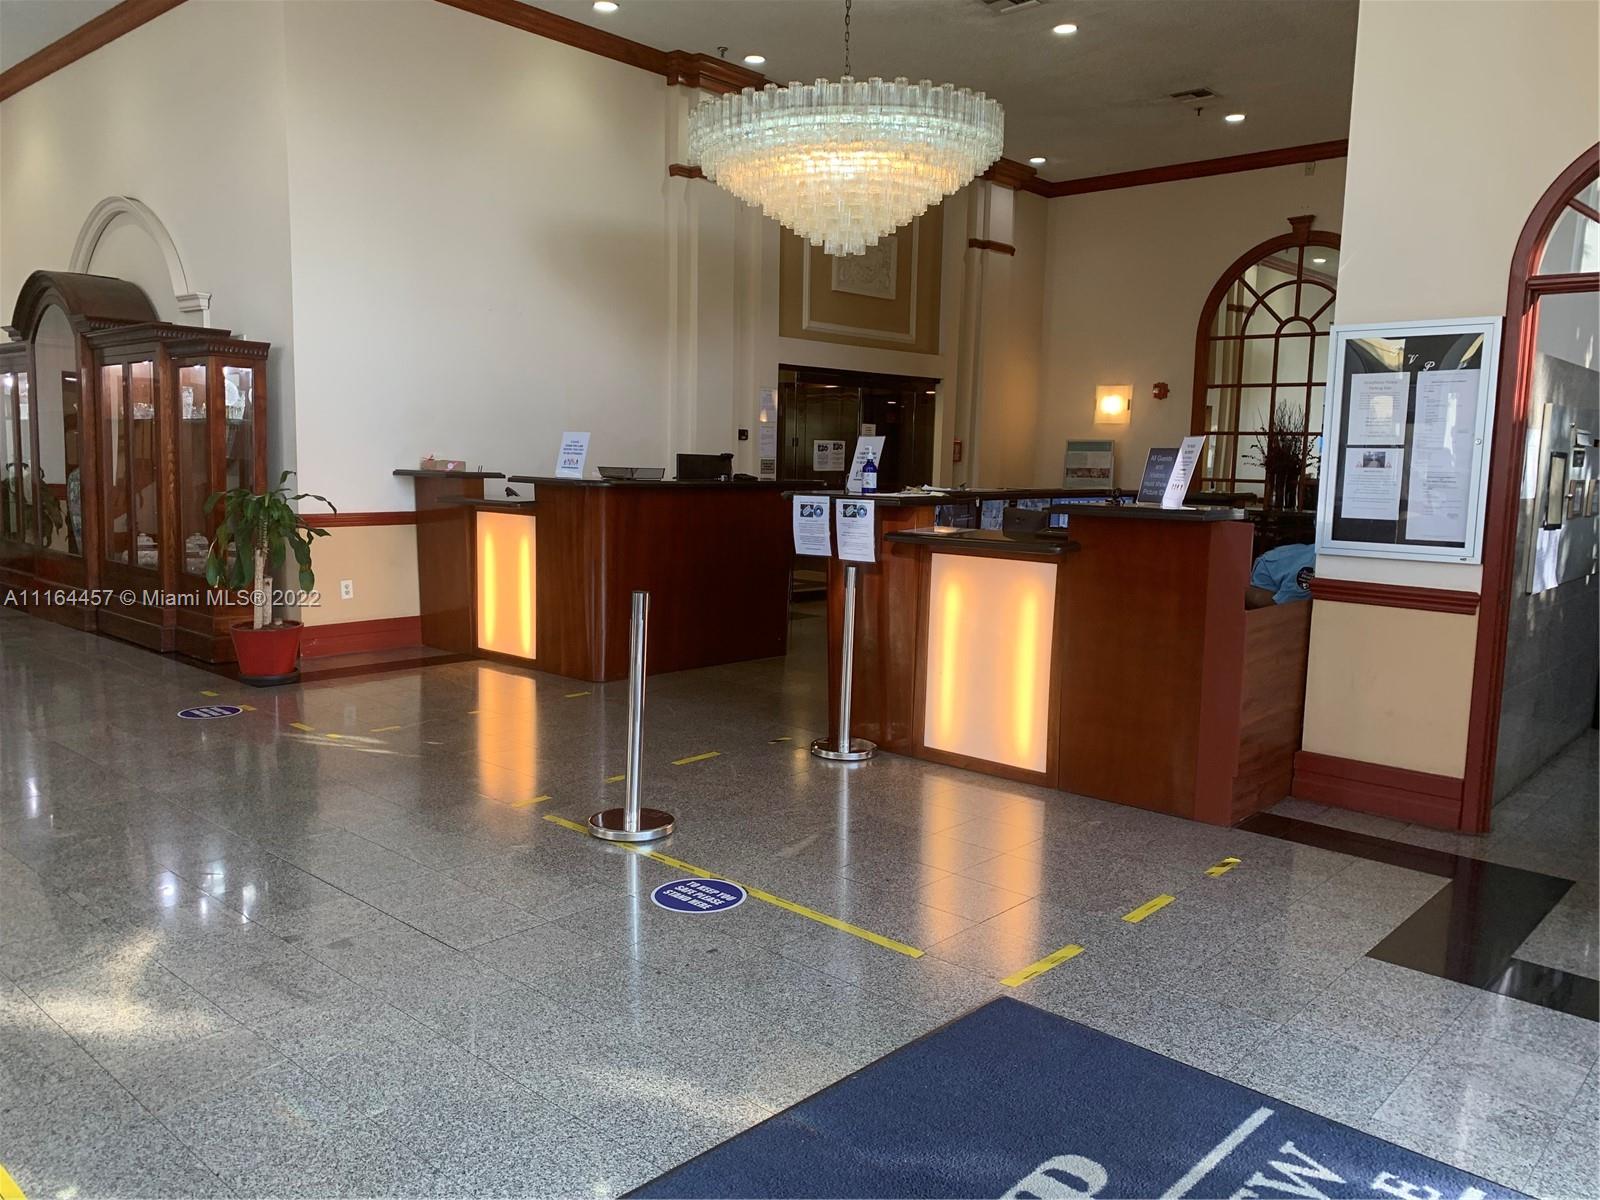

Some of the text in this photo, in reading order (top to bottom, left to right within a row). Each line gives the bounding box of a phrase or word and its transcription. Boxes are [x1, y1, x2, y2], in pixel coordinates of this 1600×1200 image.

[1407, 354, 1419, 365] V
[662, 889, 713, 910] STAND HERE
[674, 885, 726, 906] SAFE PLEASE
[697, 885, 720, 895] KEEP
[716, 892, 737, 902] YOU
